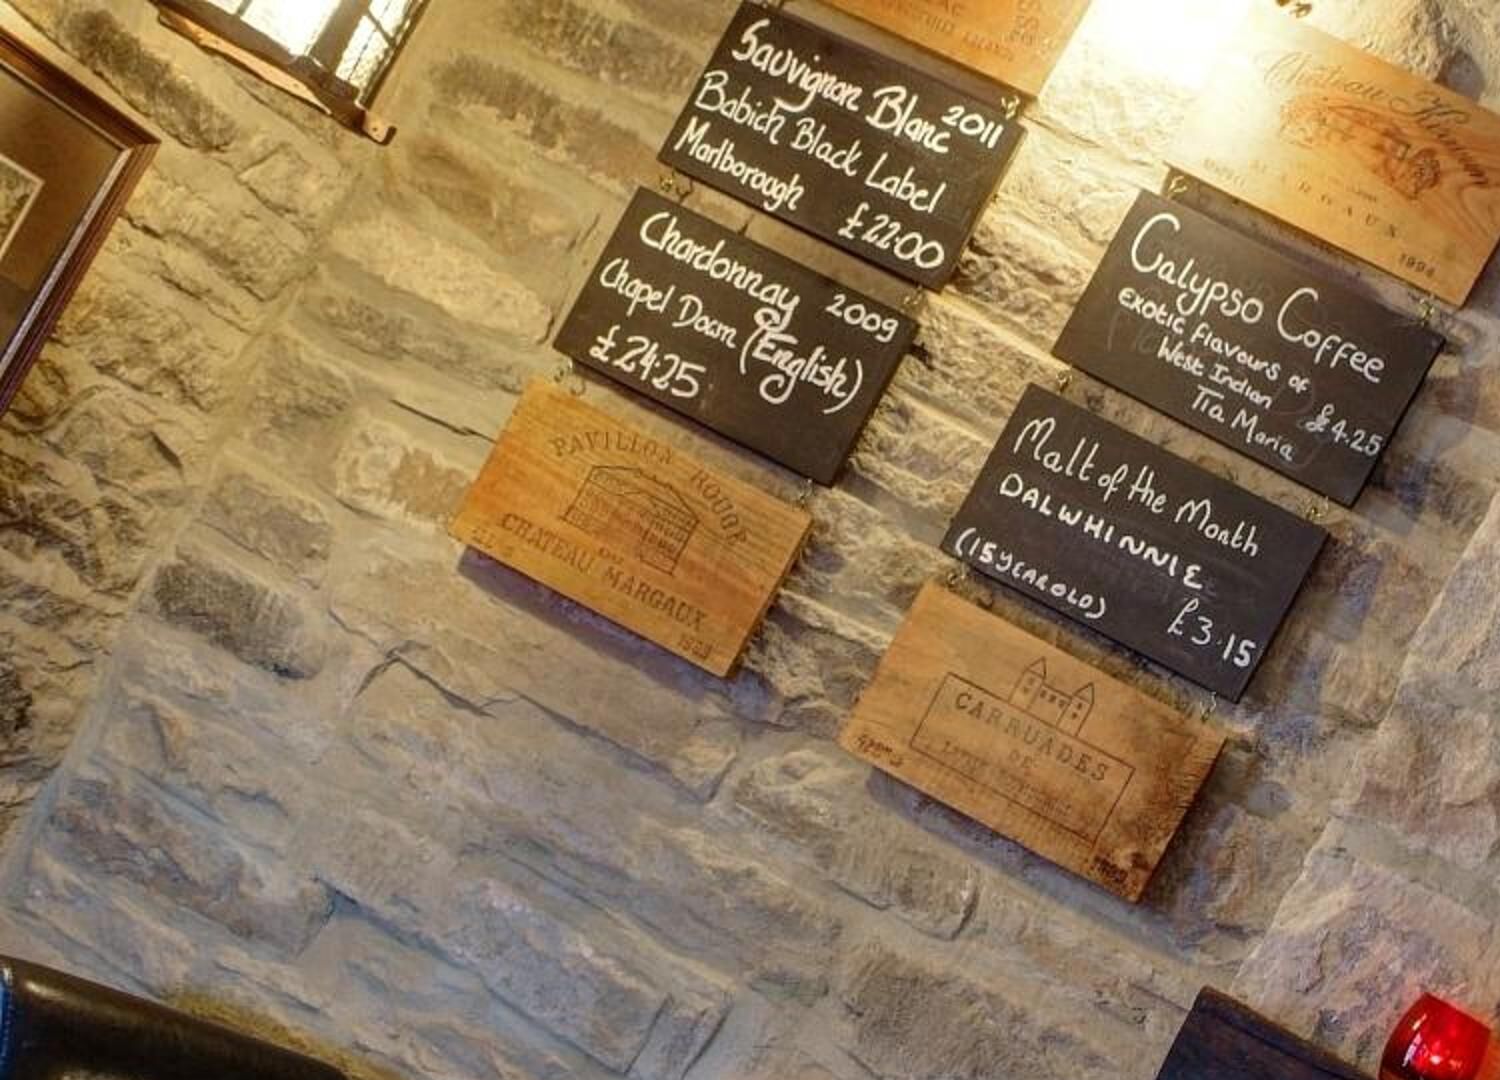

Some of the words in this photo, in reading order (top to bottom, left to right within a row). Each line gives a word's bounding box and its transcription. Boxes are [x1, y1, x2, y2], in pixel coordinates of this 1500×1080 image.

[731, 19, 861, 113] Sauvignon
[866, 86, 949, 154] Blanc
[941, 105, 1003, 149] 2011
[673, 117, 806, 212] Marlborough
[694, 71, 784, 145] Babich
[795, 118, 858, 178] Black
[865, 150, 948, 215] Label
[599, 257, 676, 317] Chapel
[672, 294, 741, 350] Down
[639, 211, 801, 333] Chardonnay
[1130, 213, 1264, 324] Calypso
[1276, 287, 1386, 384] Coffee
[826, 294, 900, 344] 2009
[1156, 334, 1207, 378] West
[1207, 362, 1274, 411] Indian
[1191, 383, 1225, 425] Tia
[1230, 408, 1297, 463] Maria
[1303, 402, 1384, 458] £4.25
[998, 471, 1204, 591] DALWHINNIE
[1013, 416, 1100, 483] Malt
[1097, 462, 1130, 504] of
[1125, 464, 1168, 514] the
[1173, 498, 1261, 559] Month
[1166, 596, 1257, 669] £3.15
[953, 691, 1110, 783] CARRUADES
